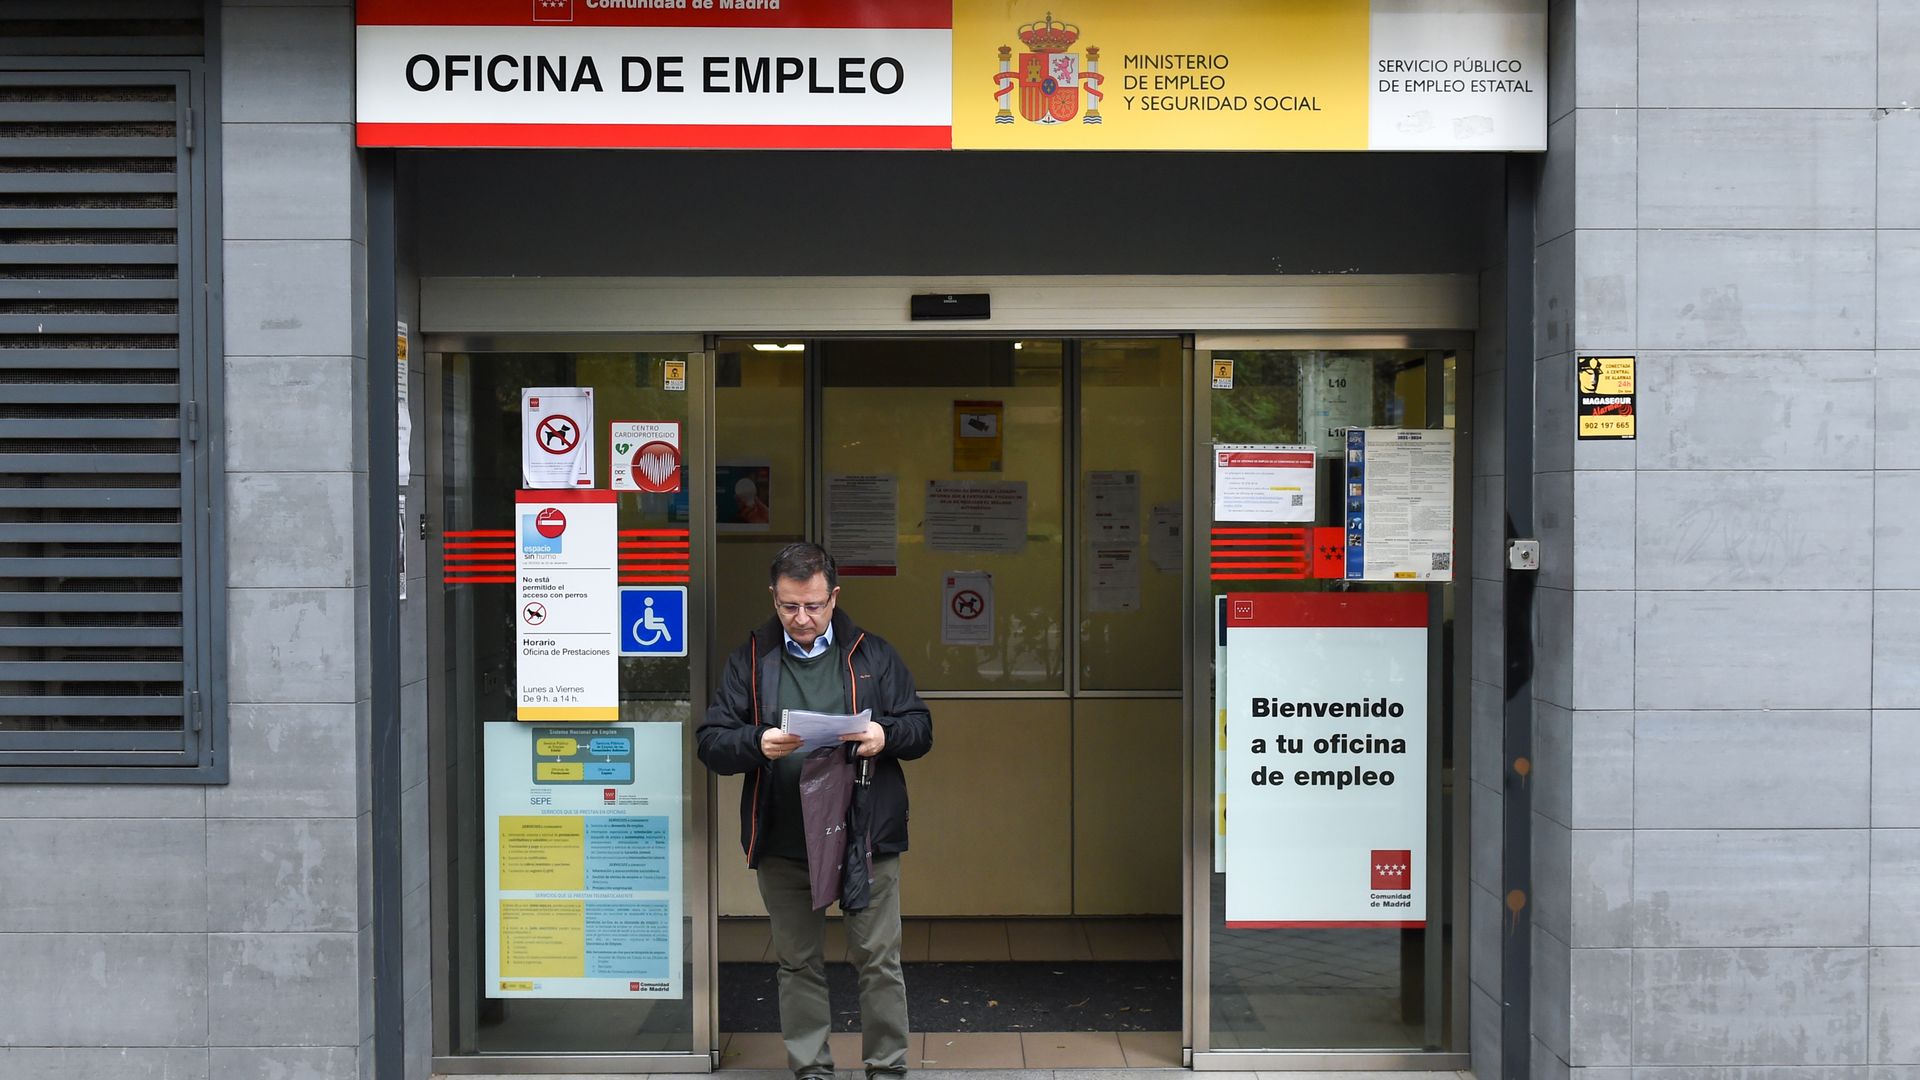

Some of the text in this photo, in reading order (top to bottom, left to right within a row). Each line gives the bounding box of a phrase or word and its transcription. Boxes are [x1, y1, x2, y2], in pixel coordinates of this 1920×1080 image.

[585, 0, 780, 9] Comunidad de Madrid
[1124, 54, 1229, 70] MINISTERIO
[1378, 56, 1522, 73] SERVICIO PÚBLICO
[405, 54, 905, 95] OFICINA DE EMPLEO
[1124, 75, 1226, 91] DE EMPLEO
[1378, 79, 1534, 94] DE EMPLEO ESTATAL
[1123, 95, 1322, 112] Y SEGURIDAD SOCIAL
[1328, 378, 1347, 388] L10
[1582, 397, 1632, 405] MAGASEGUR
[631, 424, 660, 432] CENTRO
[614, 431, 676, 439] CARDIOPROTEGIDO
[524, 545, 551, 553] espacio
[523, 638, 556, 647] Horario
[522, 647, 611, 657] Oficina de Prestaciones
[522, 685, 547, 694] Lunes
[555, 685, 585, 694] Viernes
[522, 694, 533, 703] De
[535, 694, 541, 703] 9
[543, 694, 551, 703] h.
[560, 694, 570, 703] 14
[571, 694, 579, 703] h.
[1252, 697, 1405, 718] Bienvenido
[1251, 733, 1407, 754] a tu oficina
[1251, 765, 1395, 791] de empleo
[530, 797, 552, 806] SEPE
